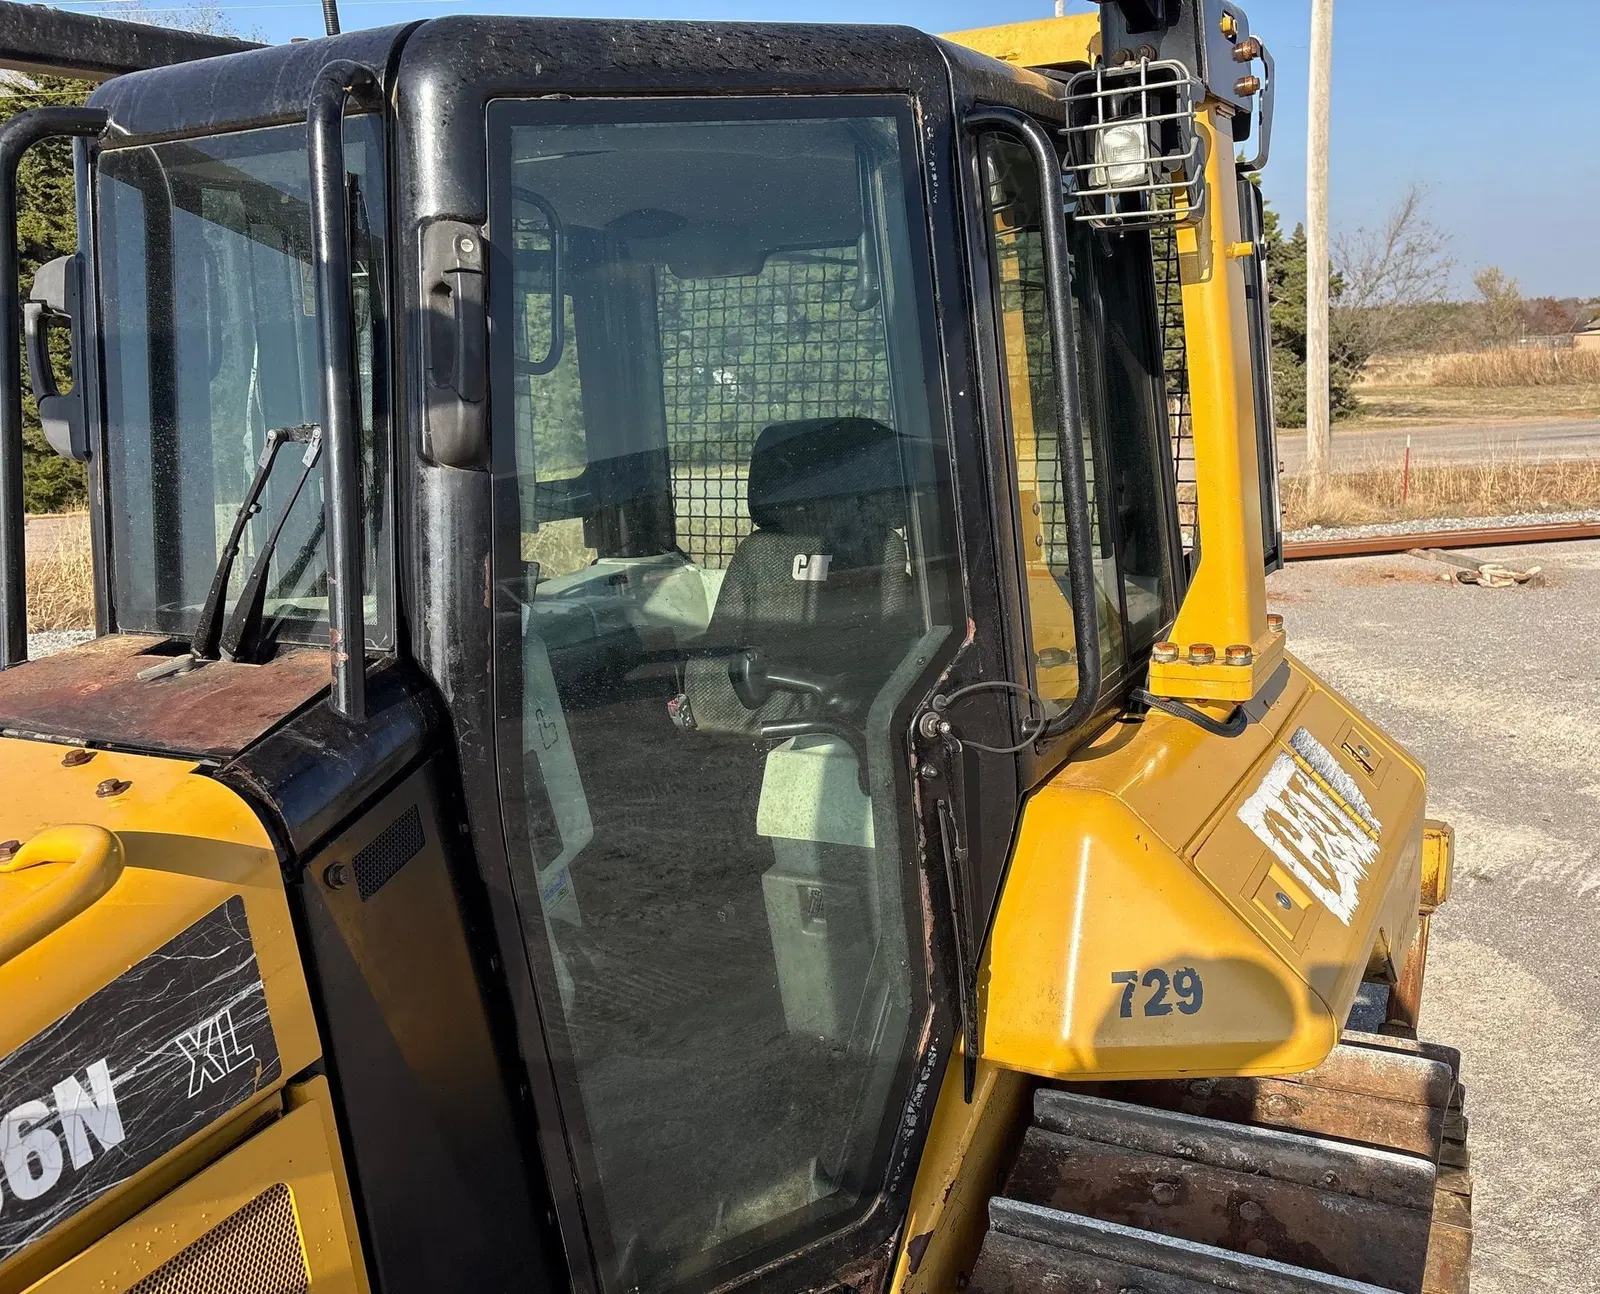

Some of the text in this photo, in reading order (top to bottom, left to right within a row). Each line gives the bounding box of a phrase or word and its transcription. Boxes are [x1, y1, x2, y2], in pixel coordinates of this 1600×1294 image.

[1111, 967, 1204, 1018] 729
[0, 1009, 255, 1213] 6N XL
